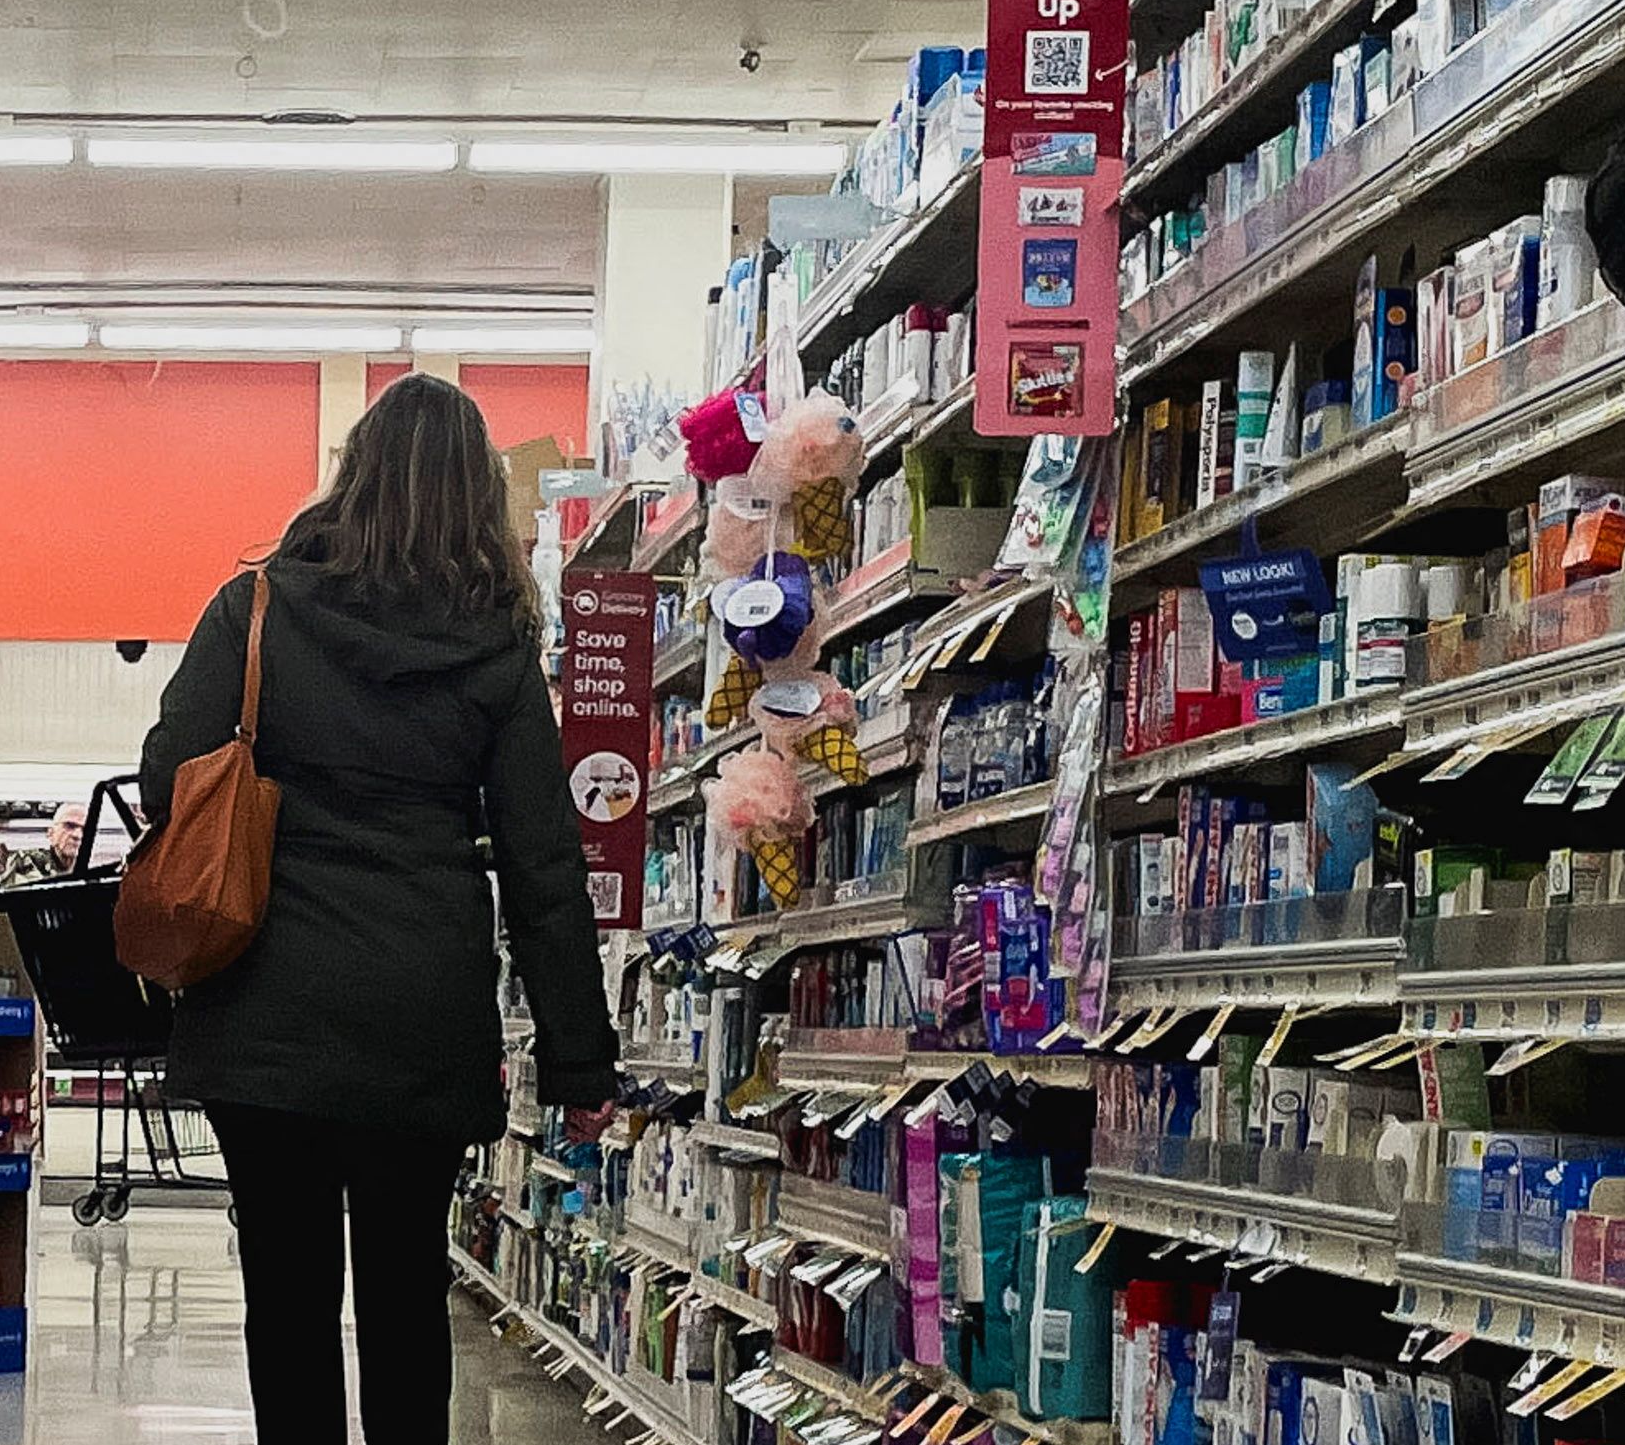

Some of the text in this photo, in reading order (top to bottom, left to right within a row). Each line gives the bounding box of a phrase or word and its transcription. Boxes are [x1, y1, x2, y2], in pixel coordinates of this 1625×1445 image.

[1221, 559, 1298, 585] NEW LOOK!
[575, 631, 625, 648] Save
[575, 654, 626, 674] time,
[574, 676, 625, 698] shop
[573, 699, 639, 718] online.
